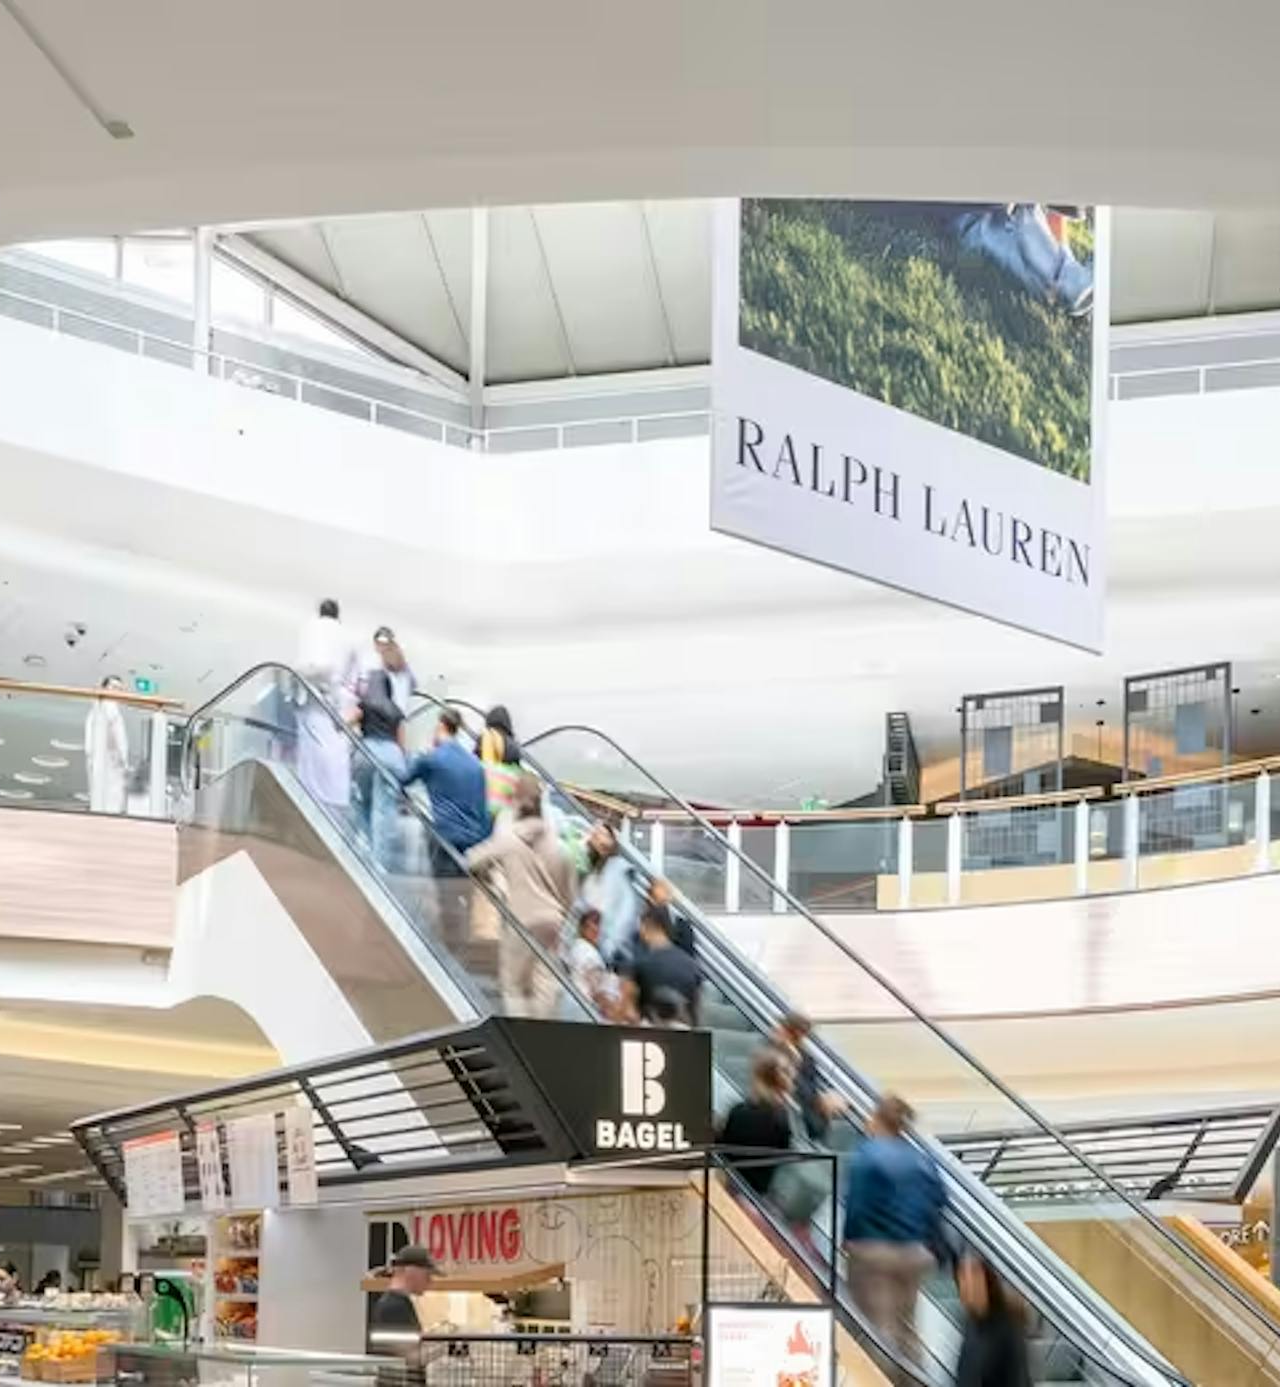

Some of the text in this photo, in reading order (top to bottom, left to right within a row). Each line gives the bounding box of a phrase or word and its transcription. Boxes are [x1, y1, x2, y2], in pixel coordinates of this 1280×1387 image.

[735, 415, 1091, 588] RALPH LAUREN
[622, 1041, 666, 1117] B
[596, 1119, 692, 1151] BAGEL
